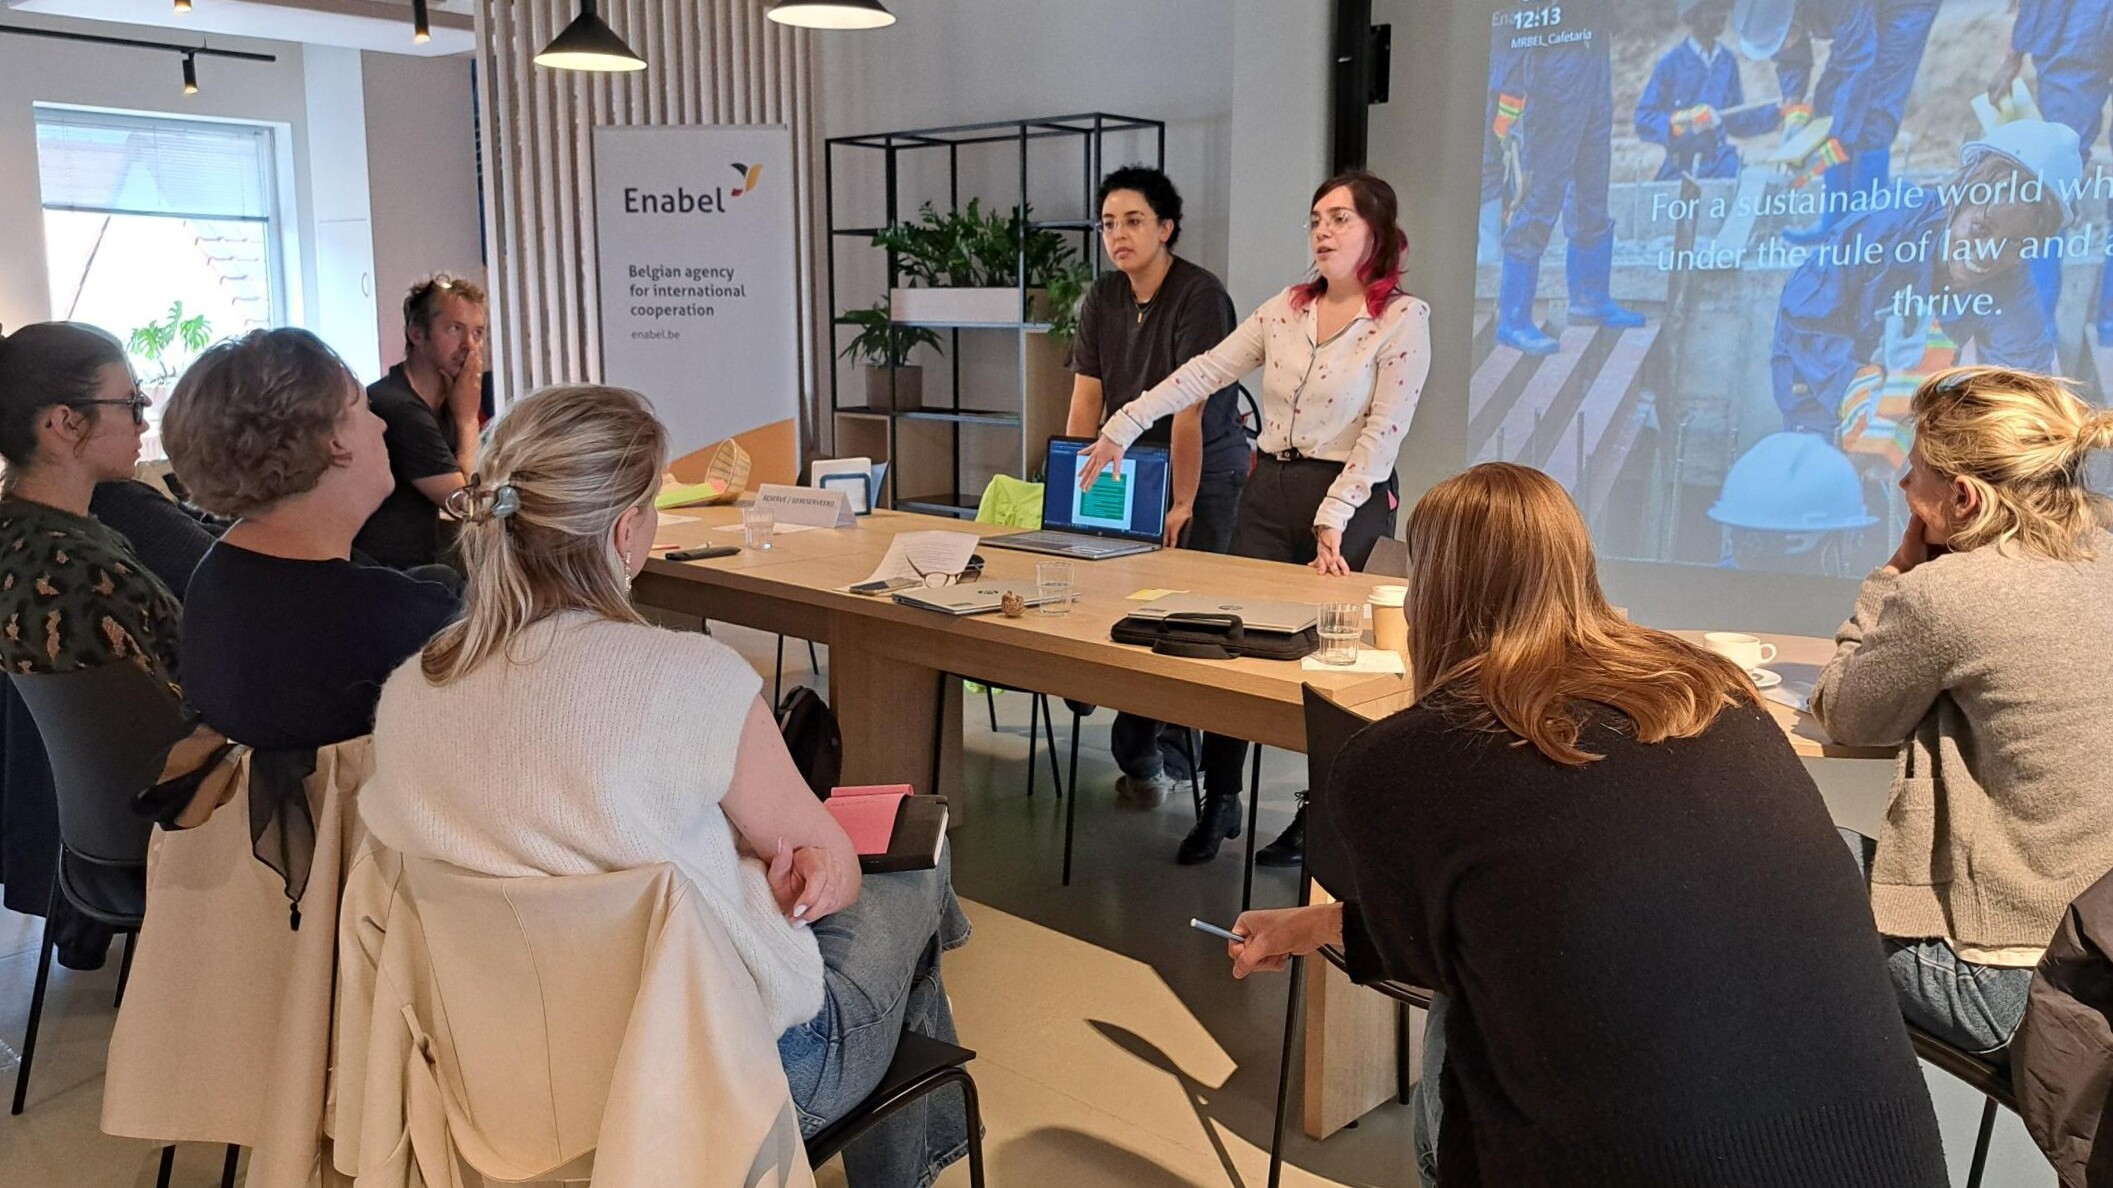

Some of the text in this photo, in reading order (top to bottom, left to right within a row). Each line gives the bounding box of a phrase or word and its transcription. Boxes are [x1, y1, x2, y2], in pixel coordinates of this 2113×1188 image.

[1514, 7, 1562, 30] 12:13
[624, 187, 726, 213] Enabel
[1651, 193, 1699, 222] For
[1709, 197, 1726, 219] a
[1737, 177, 1924, 217] sustainable
[1937, 168, 2045, 207] world
[1657, 239, 1747, 272] under
[1757, 236, 1809, 268] the
[1818, 232, 1884, 266] rule
[1894, 230, 1933, 264] of
[1942, 229, 2008, 261] law
[2019, 223, 2092, 260] and
[628, 264, 735, 281] Belgian agency
[630, 284, 747, 297] for international
[1891, 284, 2002, 317] thrive.
[630, 303, 715, 319] cooperation
[631, 329, 681, 340] enabel.be
